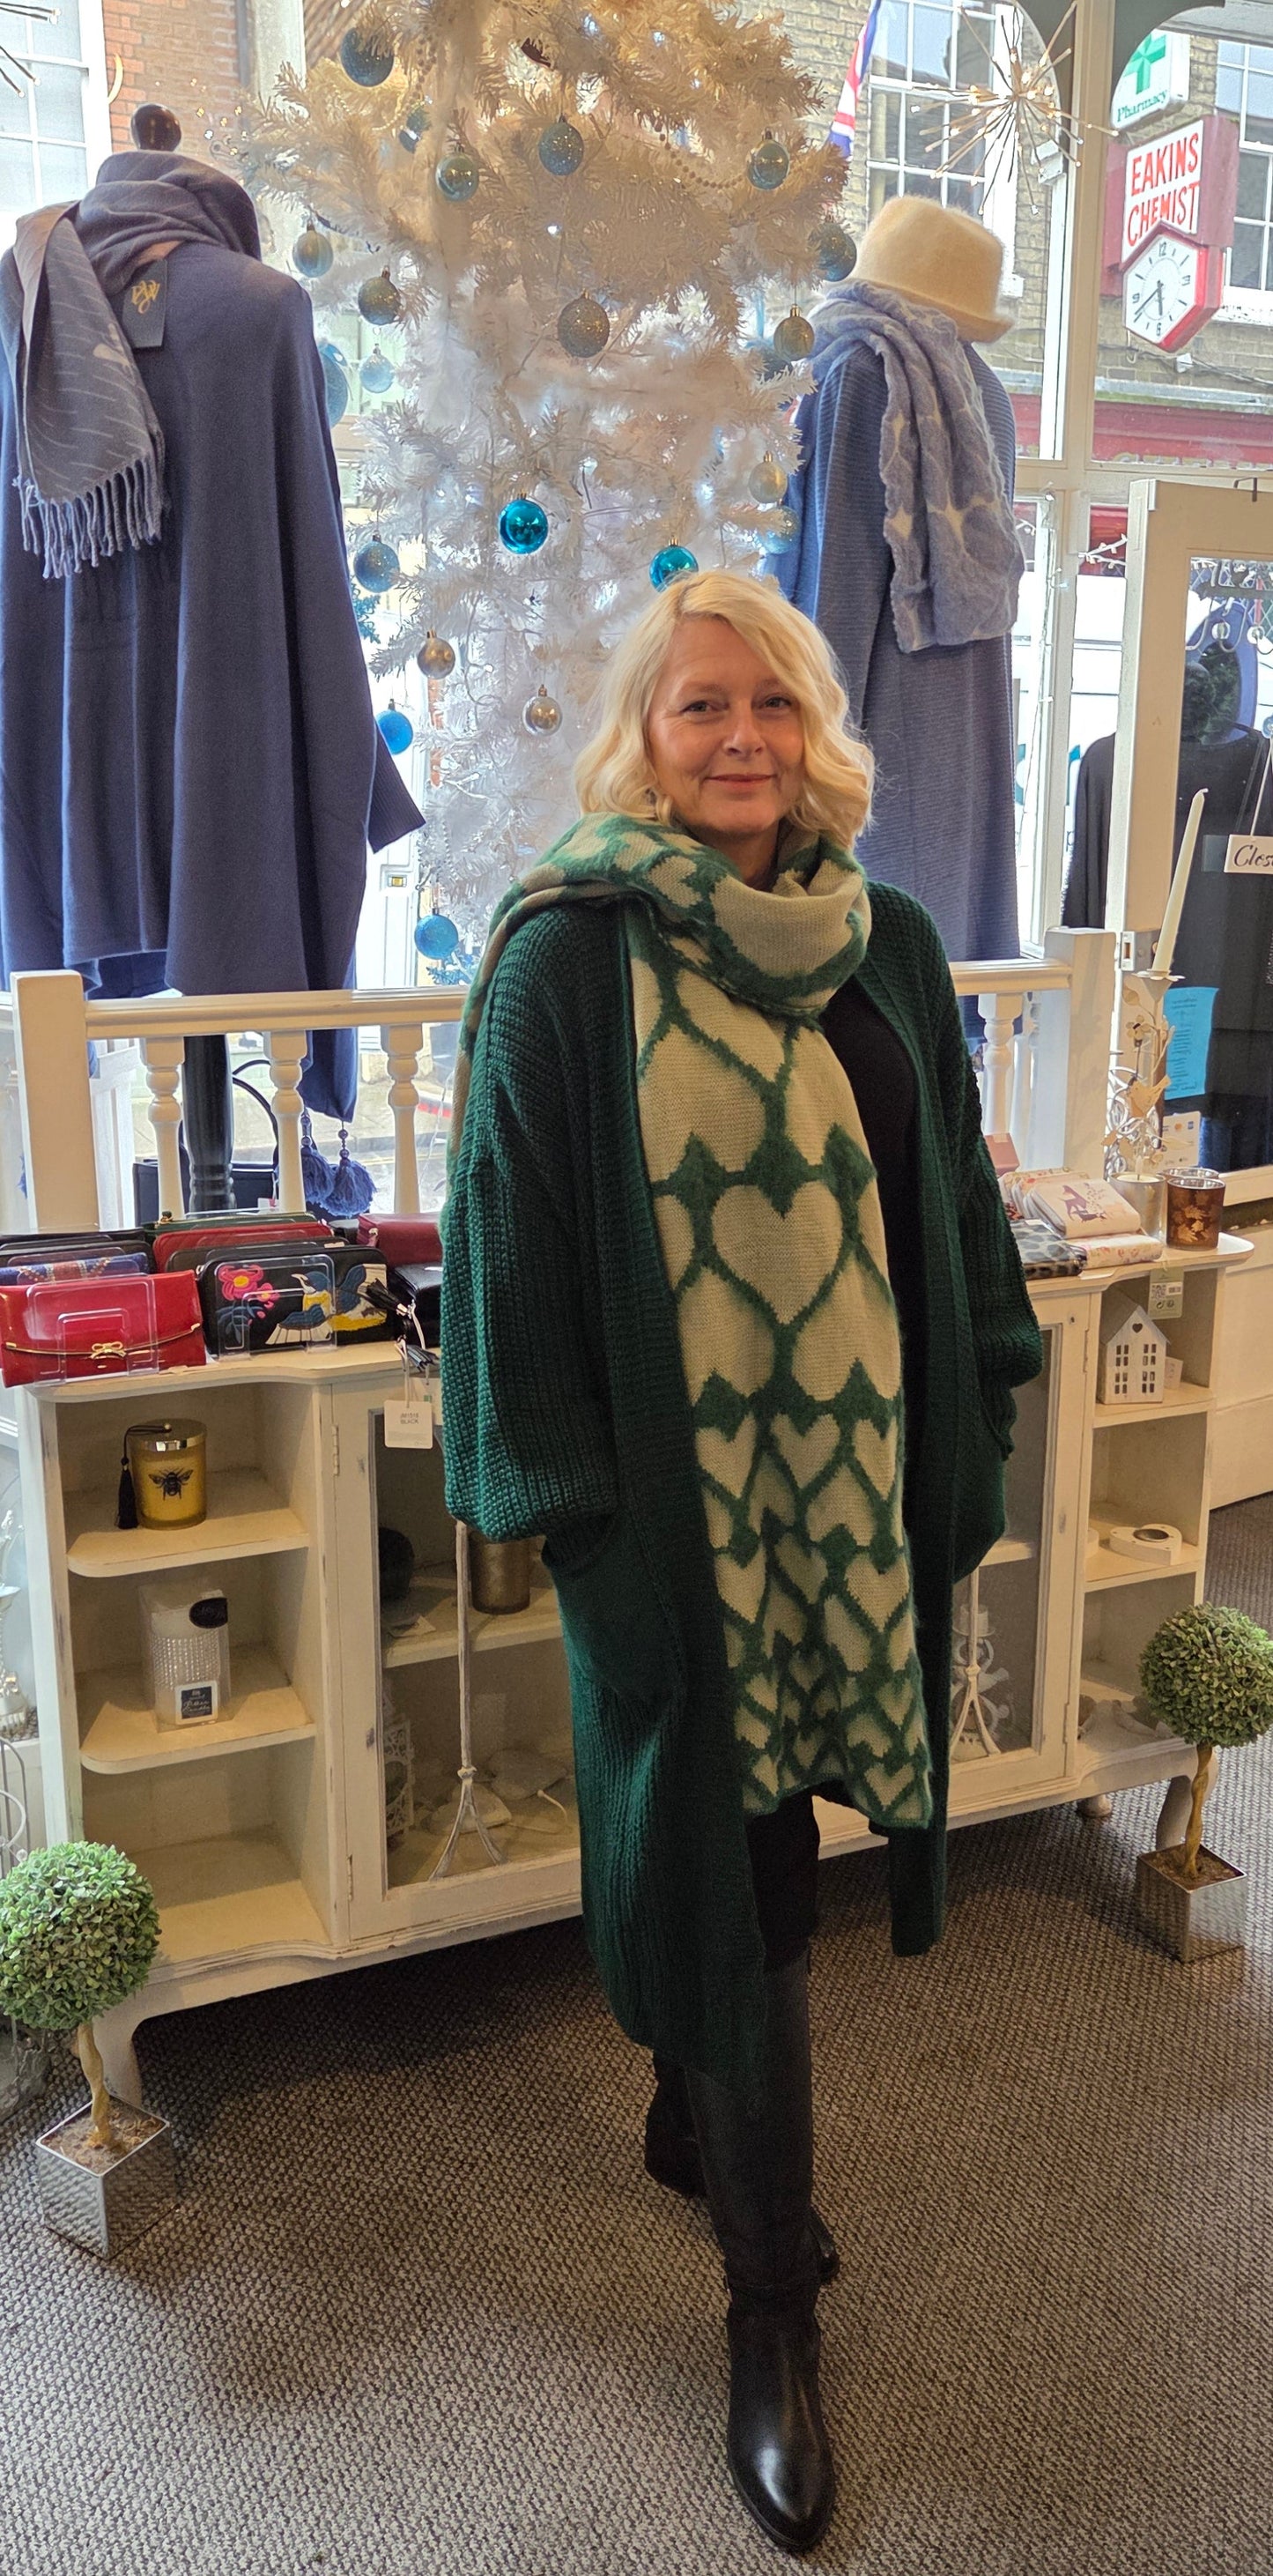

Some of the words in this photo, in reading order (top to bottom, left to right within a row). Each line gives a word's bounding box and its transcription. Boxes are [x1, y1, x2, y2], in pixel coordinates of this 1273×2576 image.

[1117, 90, 1167, 122] Pharmacy
[1131, 133, 1199, 197] EAKINS
[1128, 181, 1200, 247] CHEMIST
[1158, 241, 1167, 257] 12
[1181, 274, 1191, 286] 3
[1132, 293, 1141, 304] 9
[1156, 322, 1163, 337] 6
[1233, 844, 1273, 868] Clos
